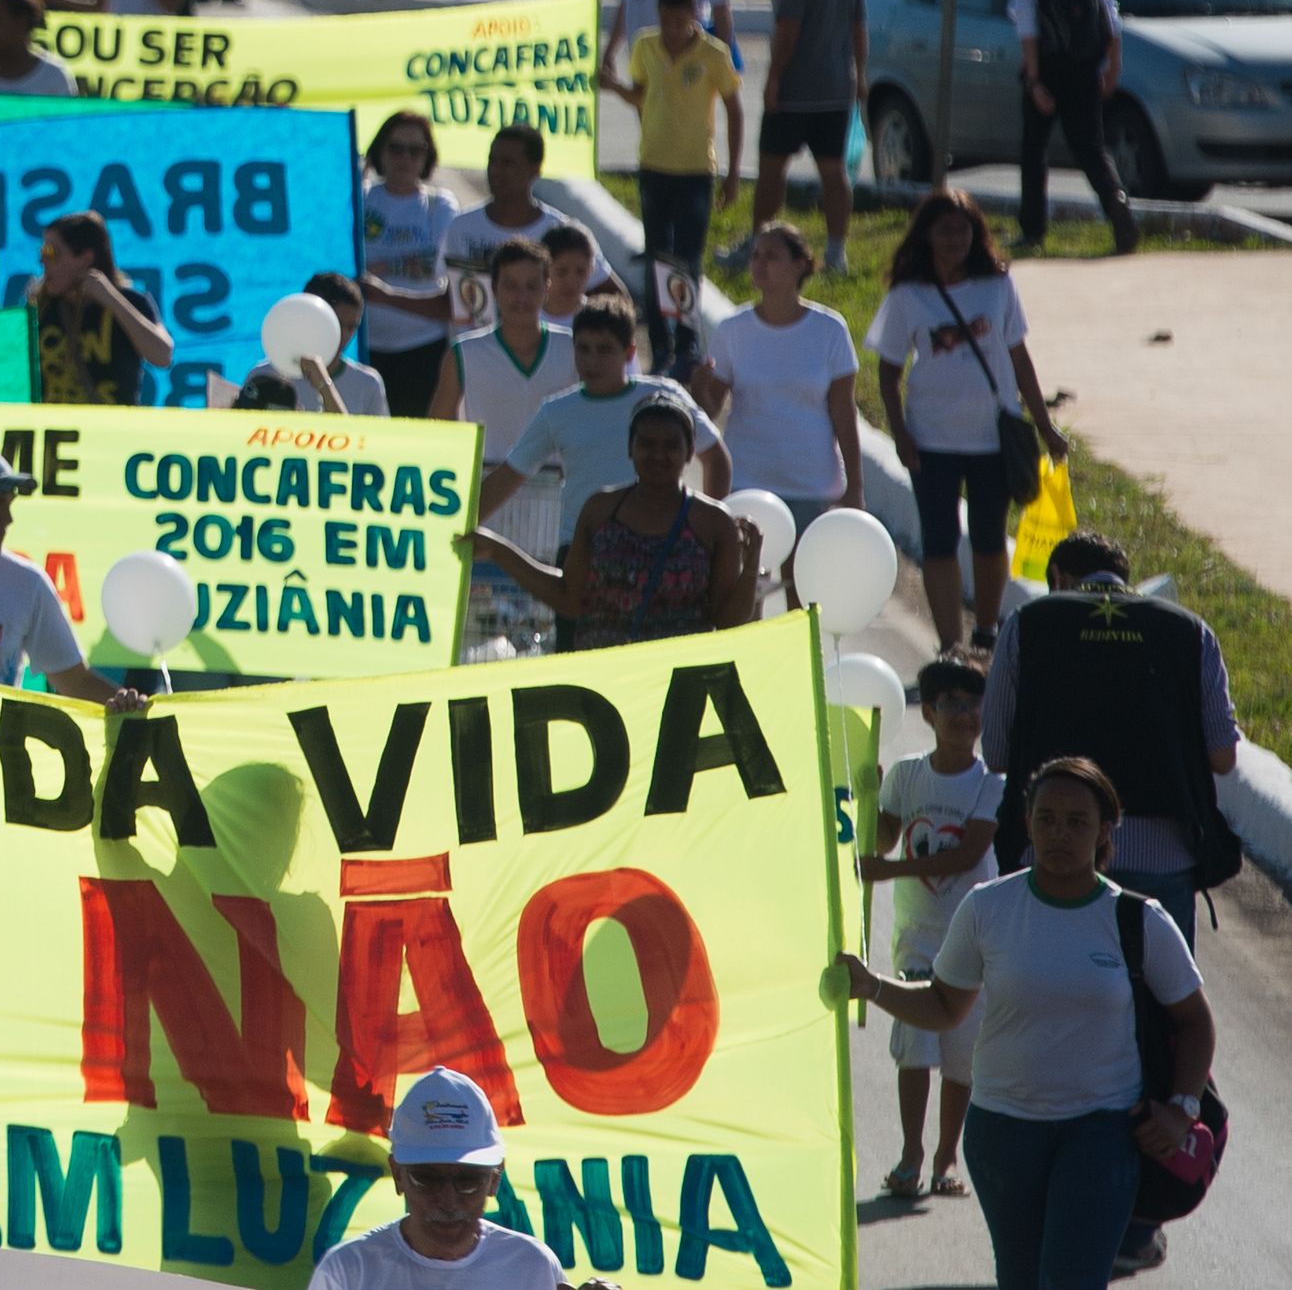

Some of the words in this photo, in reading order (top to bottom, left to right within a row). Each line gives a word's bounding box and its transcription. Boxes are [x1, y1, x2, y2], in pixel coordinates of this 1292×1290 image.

[138, 30, 231, 69] SER
[406, 32, 590, 81] CONCAFRAS
[246, 427, 366, 451] APOIO:
[124, 452, 462, 517] CONCAFRAS
[154, 512, 296, 562] 2016
[324, 520, 427, 572] EM
[287, 660, 787, 854] VIDA
[78, 852, 720, 1138] NÃO
